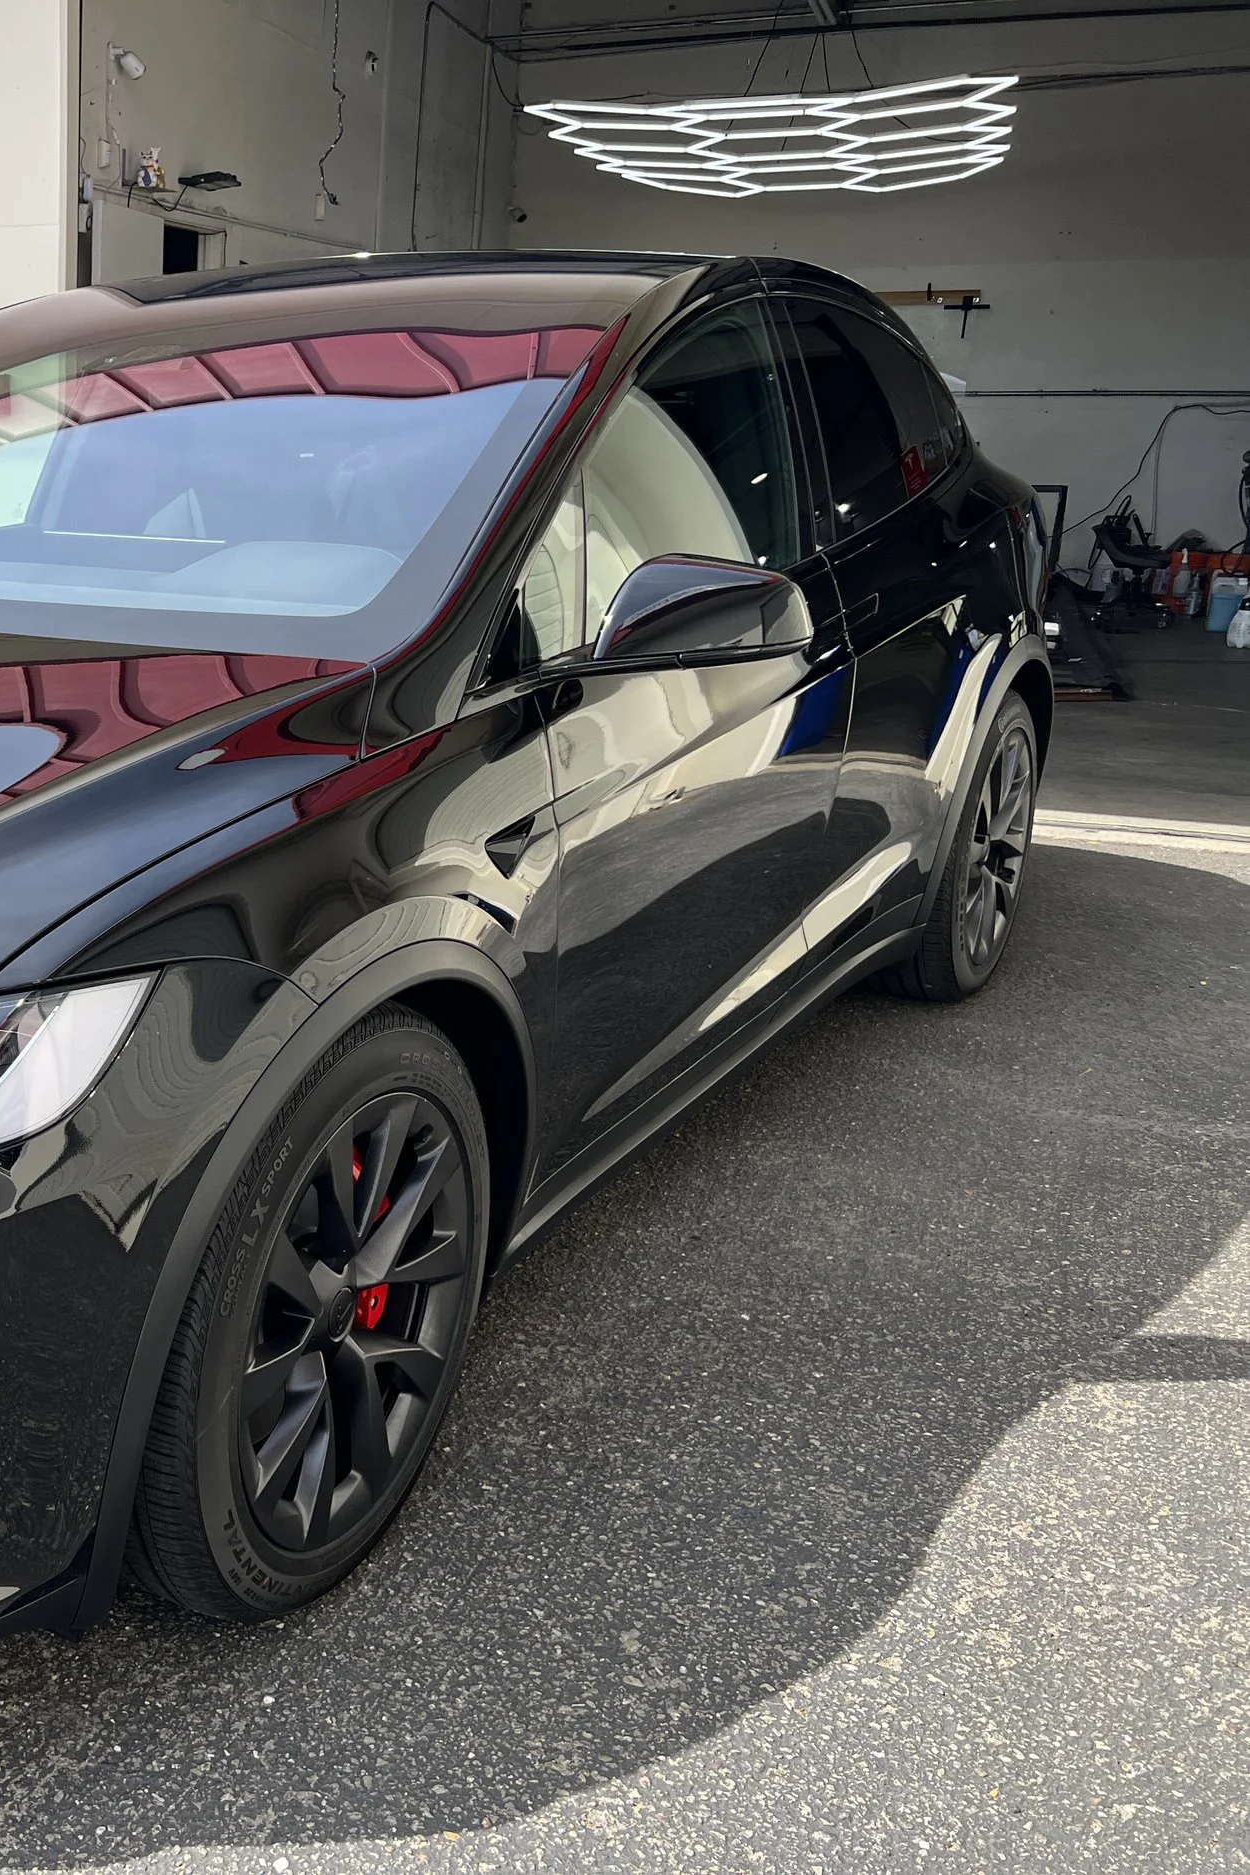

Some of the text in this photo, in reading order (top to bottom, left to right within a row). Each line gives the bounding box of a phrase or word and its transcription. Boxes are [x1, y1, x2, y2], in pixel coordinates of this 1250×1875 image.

[219, 1135, 295, 1319] CROSS LX SPORT
